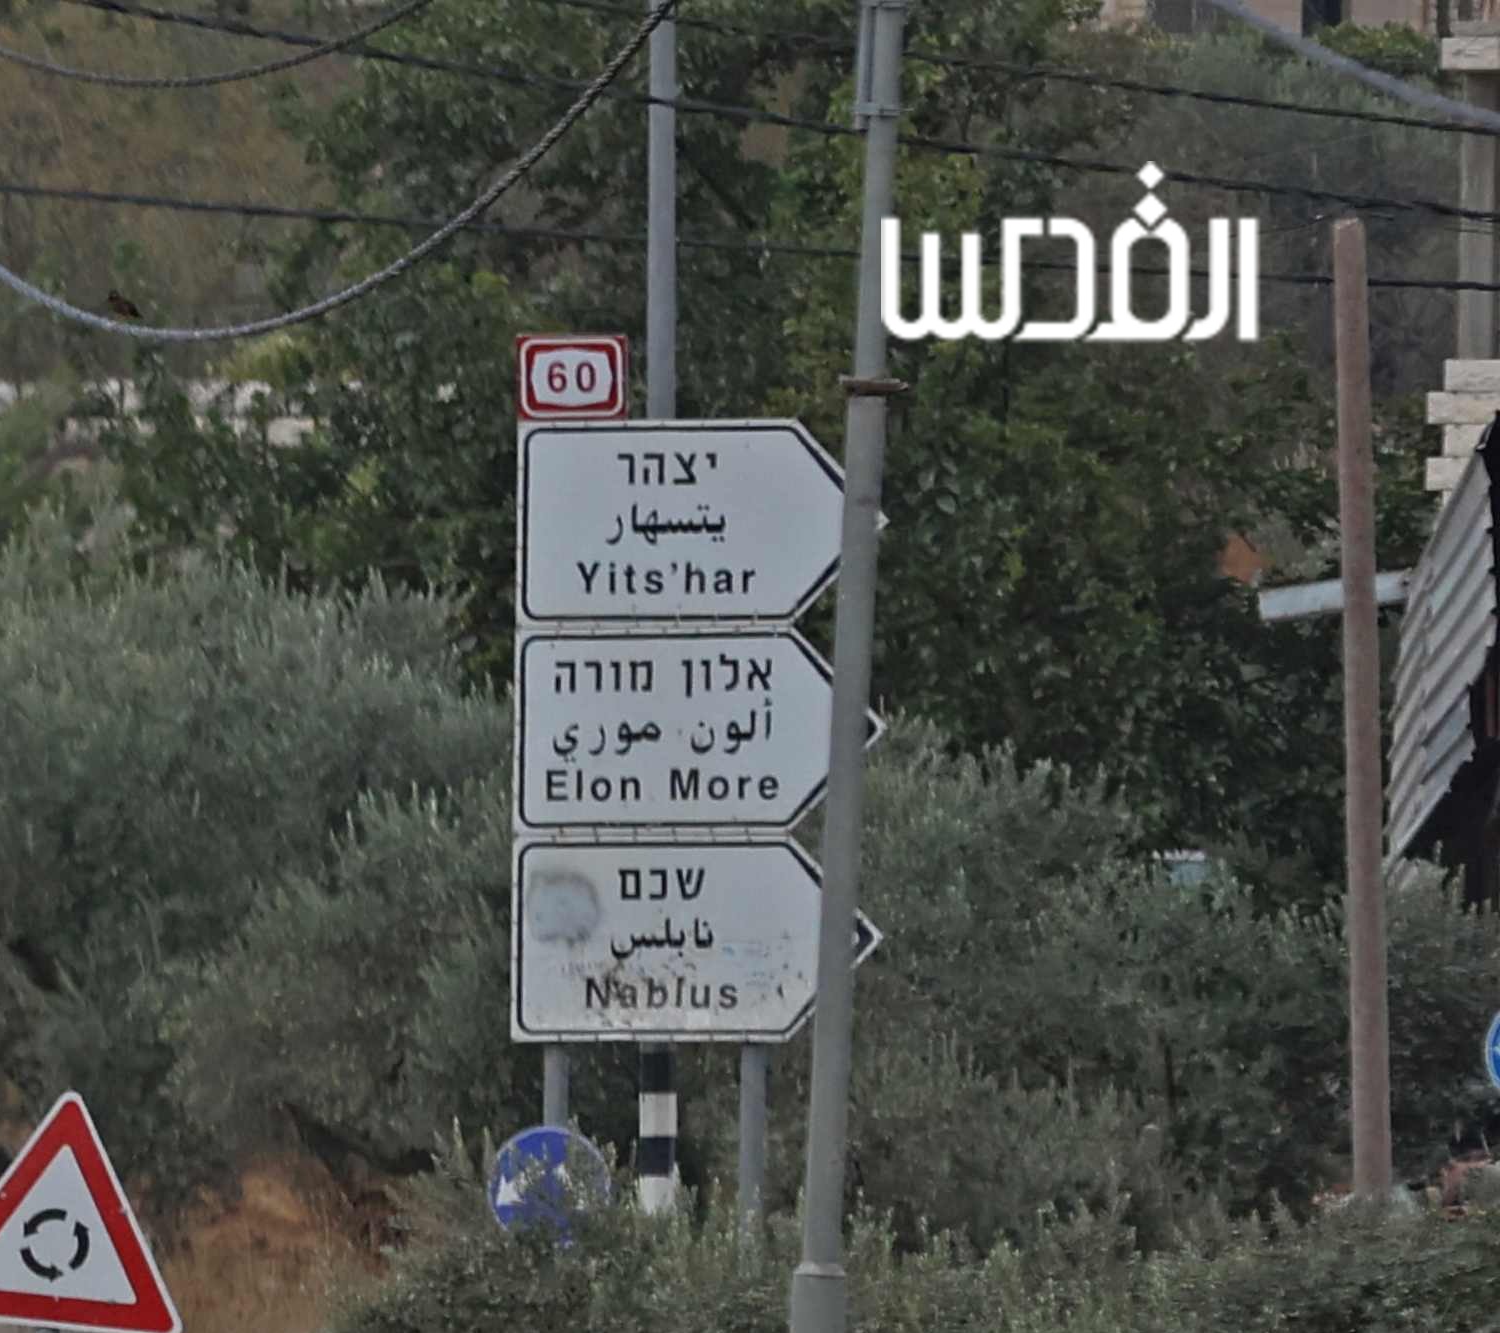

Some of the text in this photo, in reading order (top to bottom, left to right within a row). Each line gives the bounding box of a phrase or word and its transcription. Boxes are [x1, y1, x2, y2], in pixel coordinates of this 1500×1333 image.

[546, 361, 597, 393] 60
[616, 452, 718, 486] יצהר
[604, 502, 726, 545] يتسهار
[576, 561, 757, 595] Yits'har
[554, 653, 773, 698] אלון מורה
[552, 698, 773, 762] ألون موري
[545, 768, 780, 802] Elon More
[618, 867, 706, 900] שכם
[610, 918, 714, 959] نابلس
[585, 976, 739, 1010] Nablus
